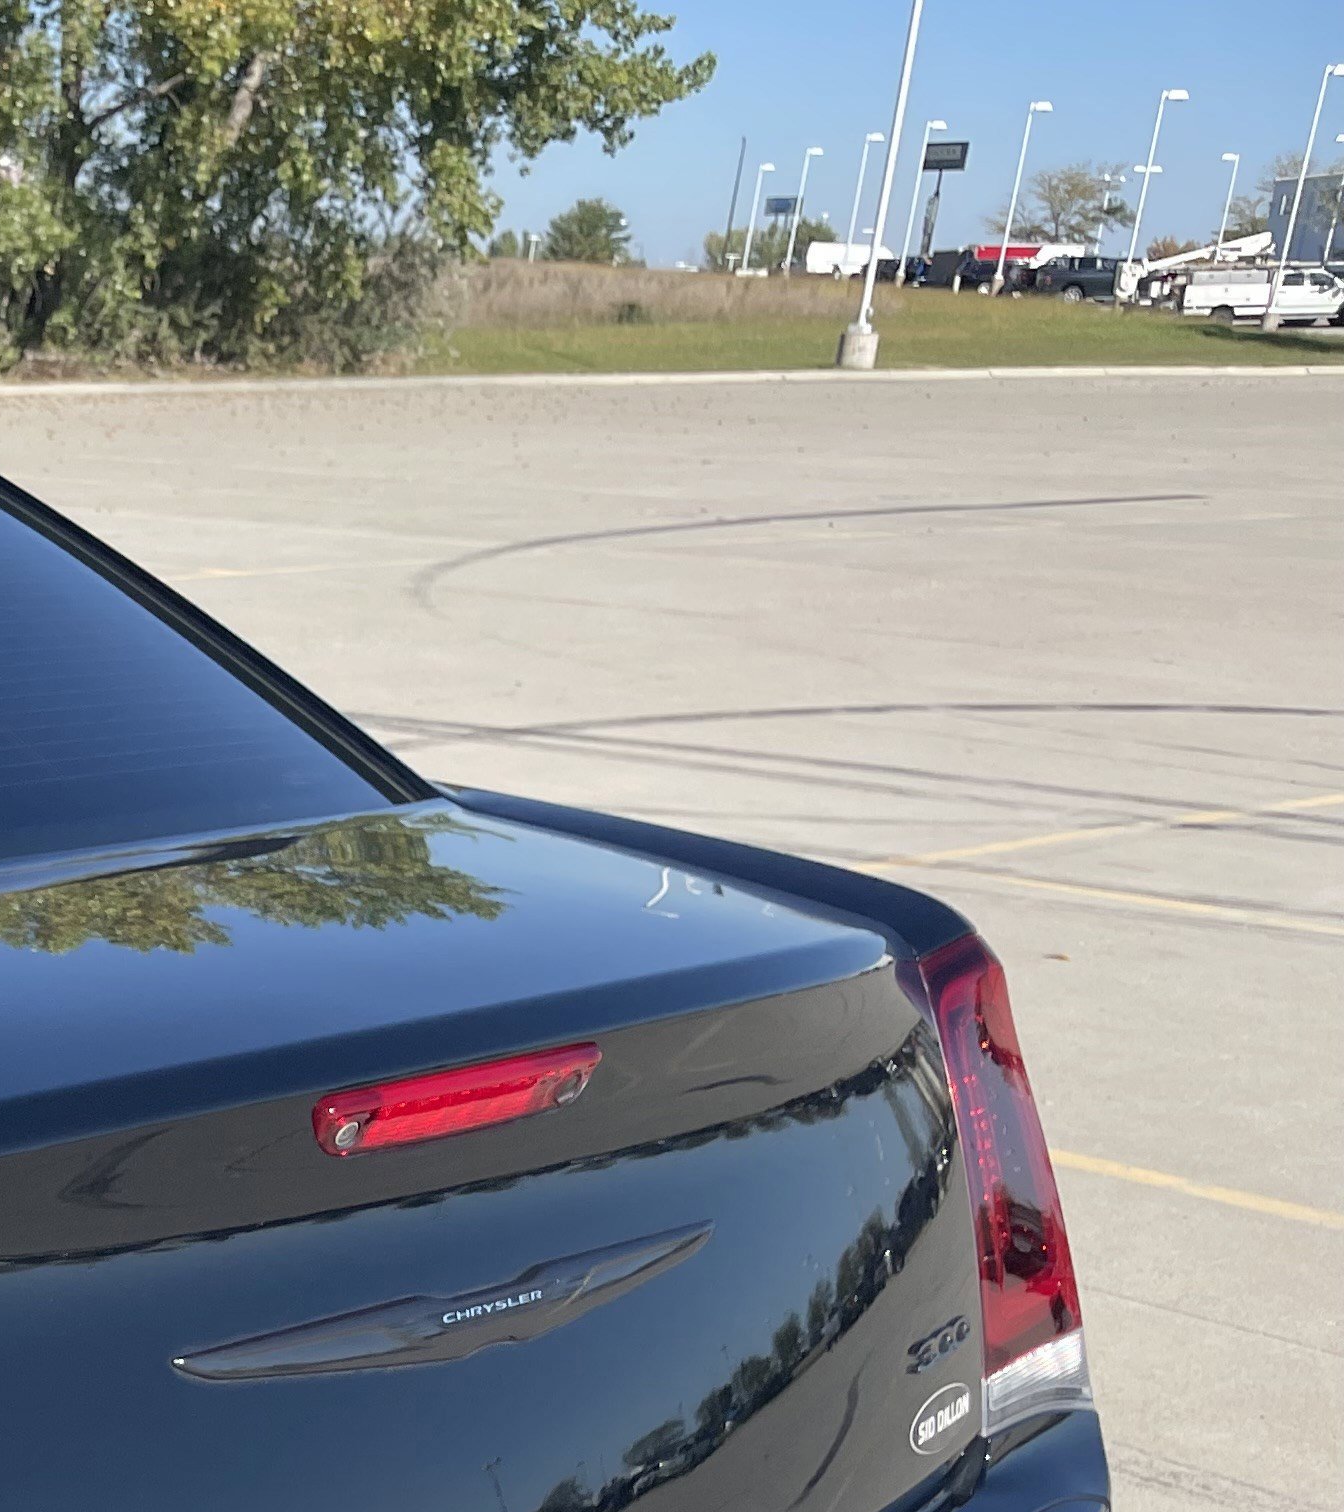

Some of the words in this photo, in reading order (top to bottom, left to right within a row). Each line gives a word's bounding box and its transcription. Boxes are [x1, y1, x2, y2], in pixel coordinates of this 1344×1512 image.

[442, 1289, 543, 1324] CHRYSLER
[916, 1415, 936, 1446] SID
[936, 1392, 970, 1433] DILLON
